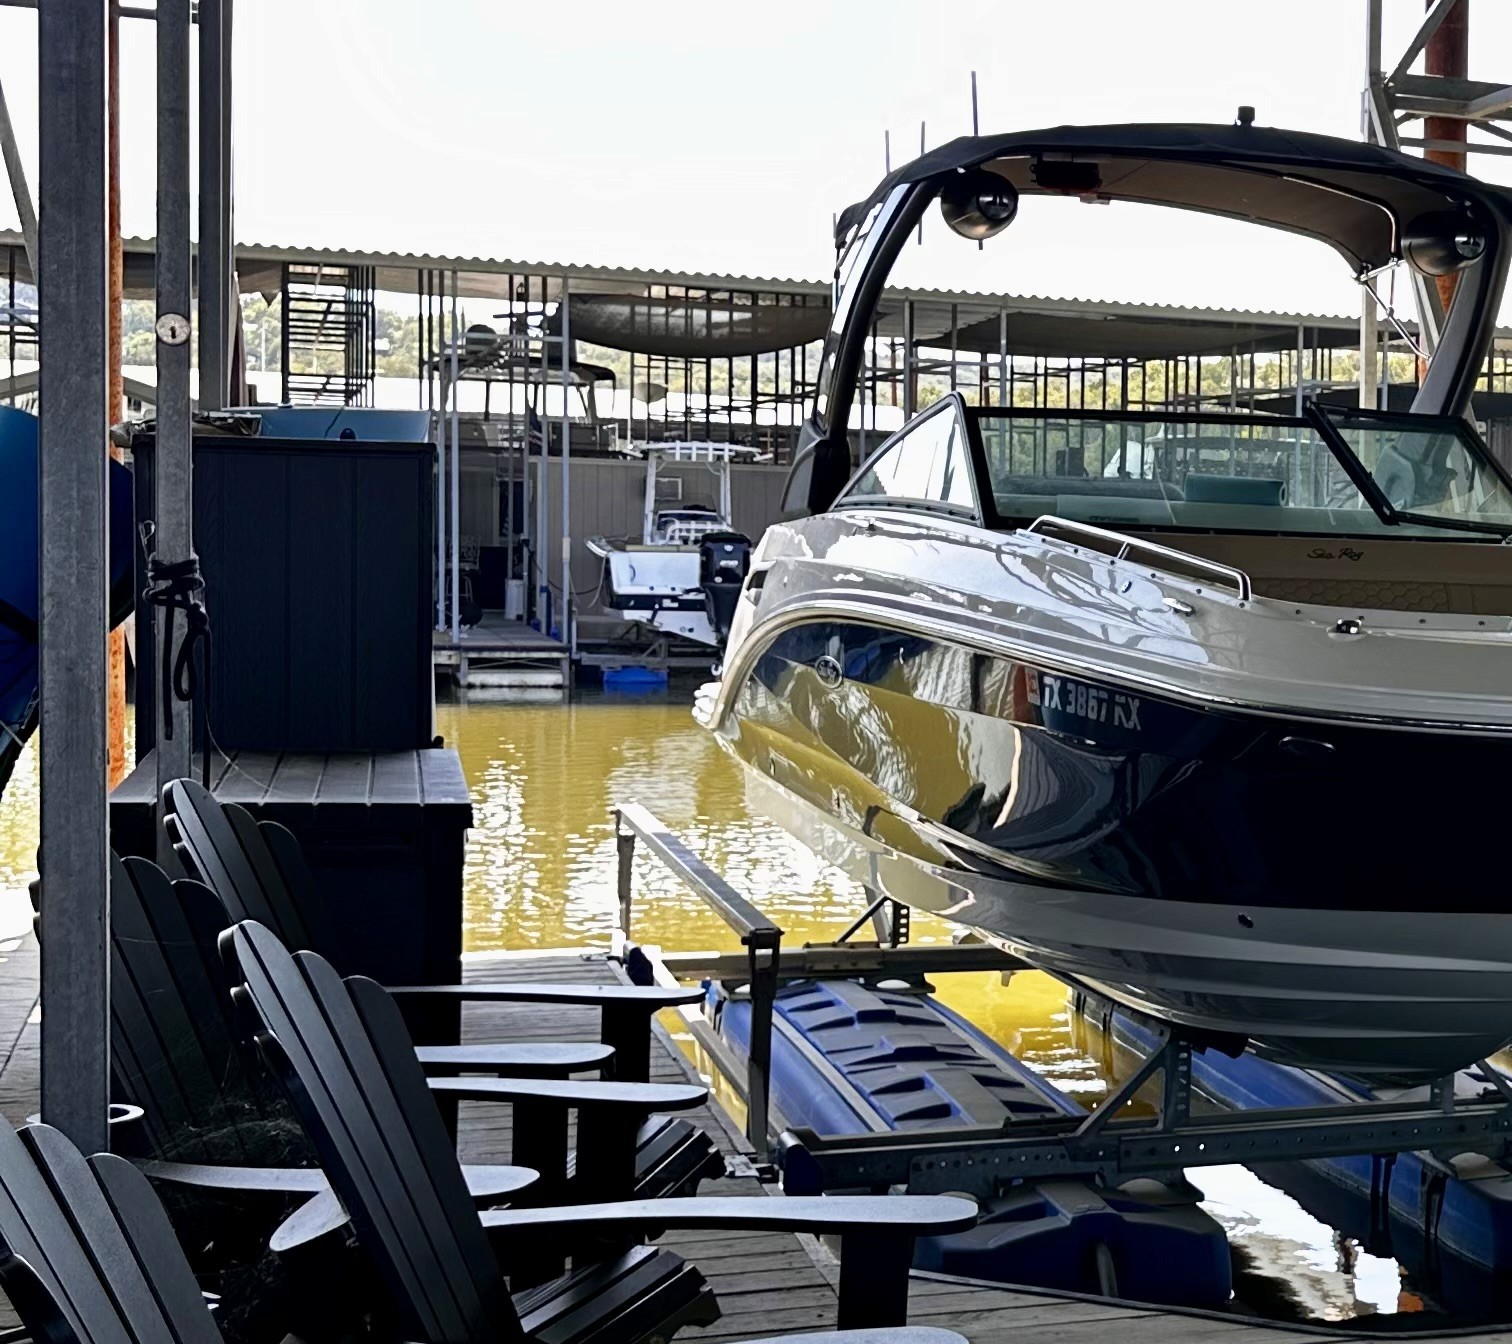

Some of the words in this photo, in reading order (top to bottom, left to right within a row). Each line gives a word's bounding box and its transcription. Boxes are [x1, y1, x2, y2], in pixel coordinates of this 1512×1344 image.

[1306, 547, 1335, 560] Sea
[1043, 676, 1062, 711] TX
[1066, 682, 1108, 723] 3867
